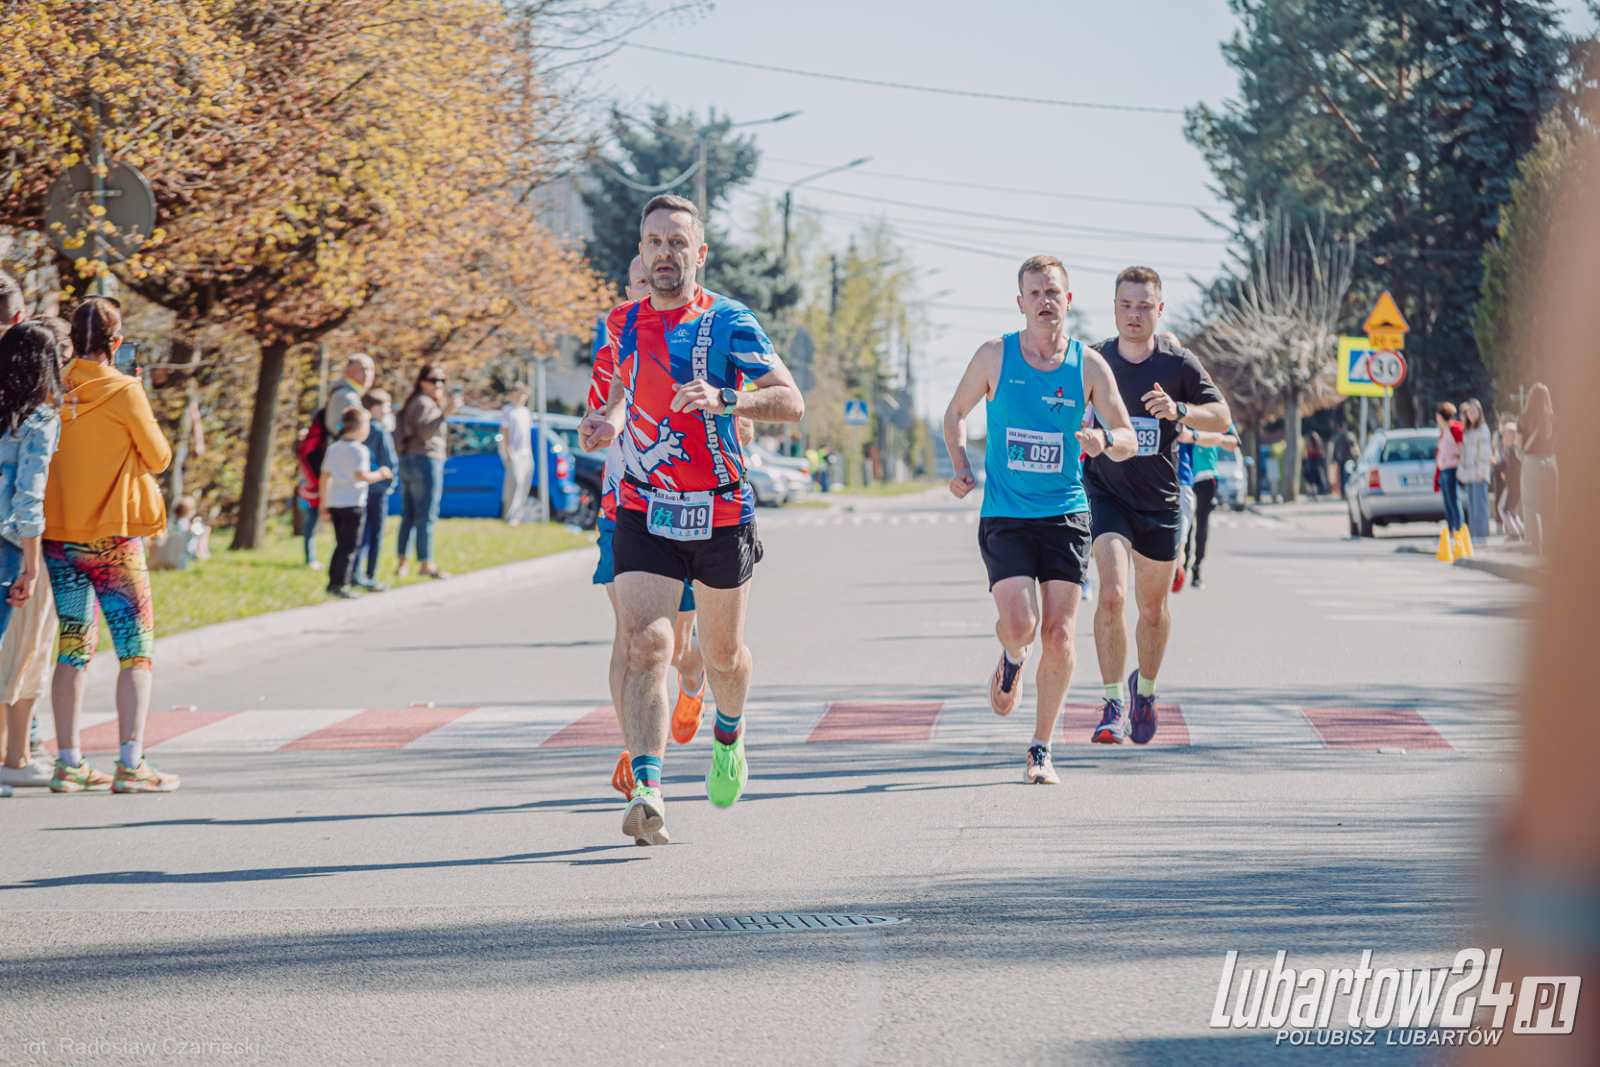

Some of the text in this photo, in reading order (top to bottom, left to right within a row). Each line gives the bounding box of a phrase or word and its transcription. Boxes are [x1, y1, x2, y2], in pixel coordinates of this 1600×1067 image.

[1375, 358, 1398, 376] 30
[1137, 430, 1156, 446] 93
[1030, 445, 1059, 462] 097
[679, 507, 706, 527] 019
